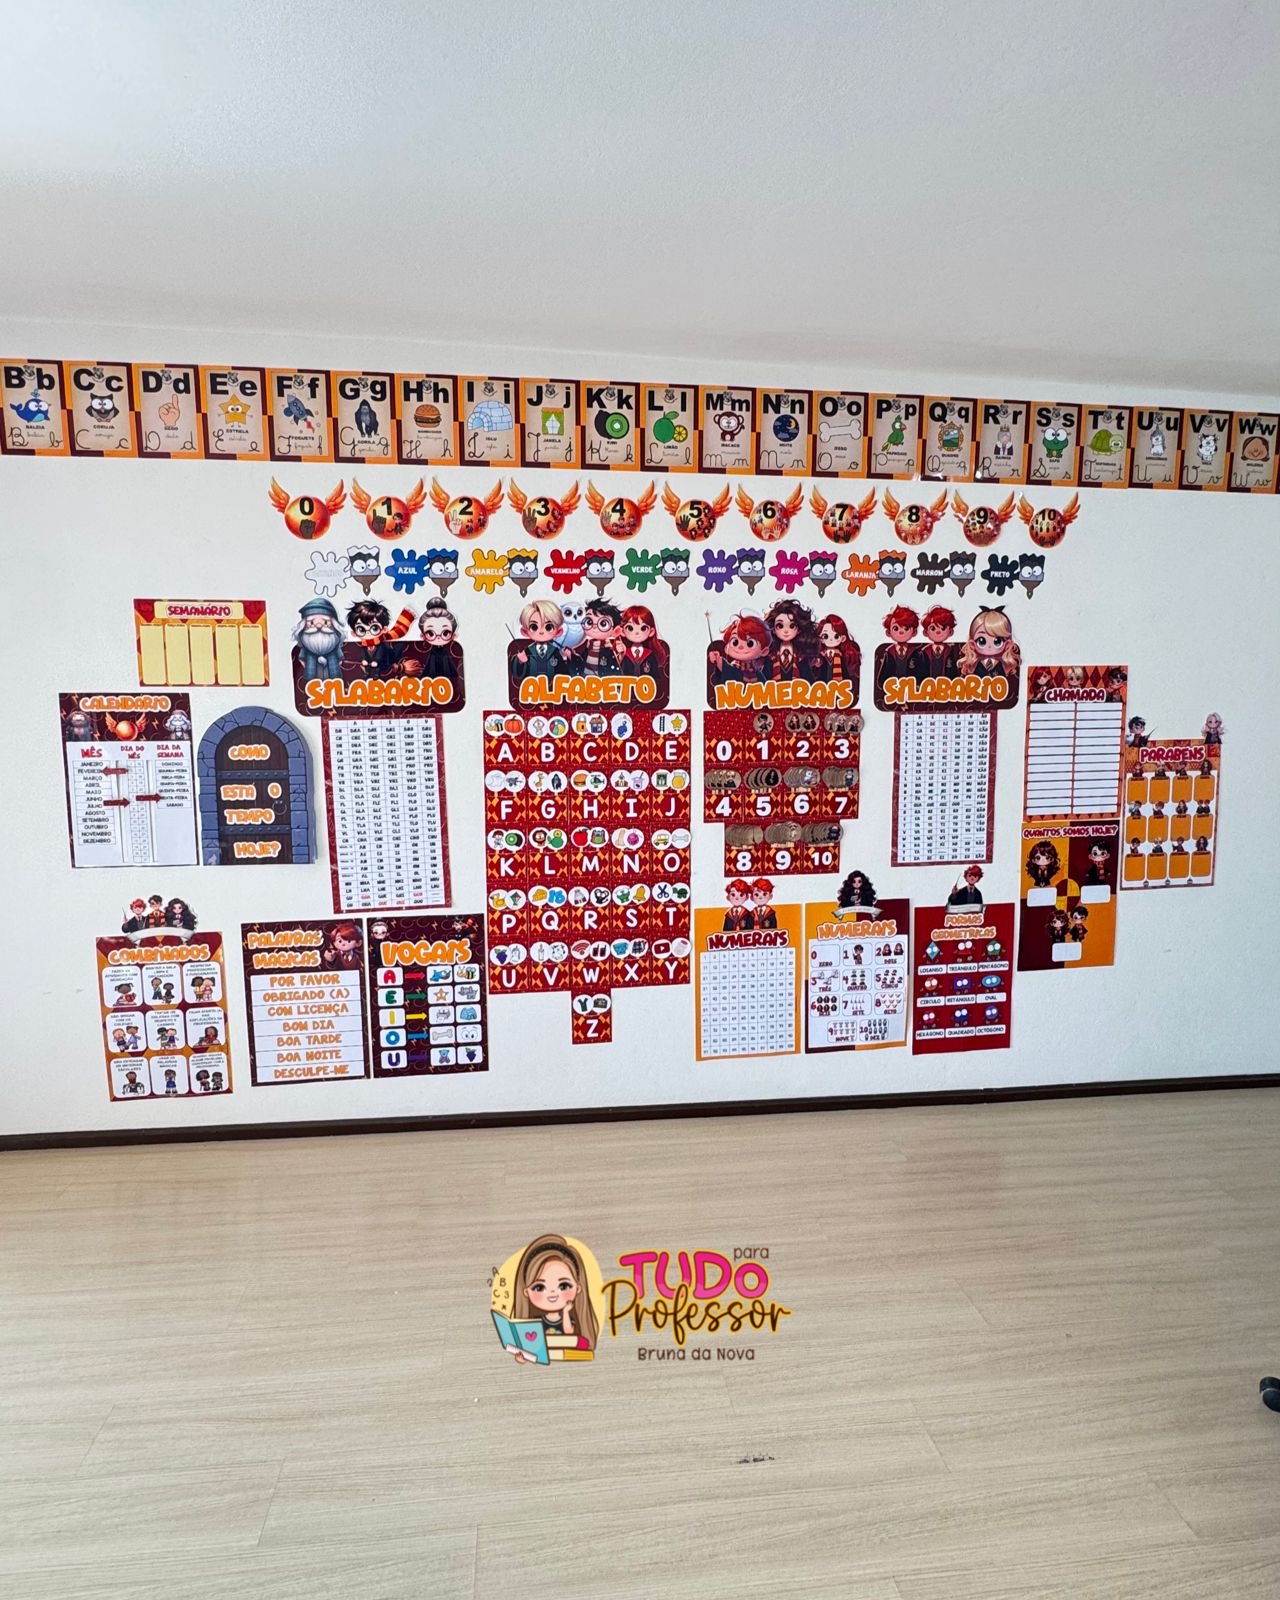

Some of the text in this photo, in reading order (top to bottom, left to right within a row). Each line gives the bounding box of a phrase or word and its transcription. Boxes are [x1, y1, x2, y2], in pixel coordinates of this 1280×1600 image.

[299, 497, 315, 516] 0
[382, 497, 393, 516] 1
[459, 497, 474, 516] 2
[536, 497, 551, 517] 3
[611, 498, 626, 516] 4
[689, 501, 703, 518] 5
[762, 501, 776, 519] 6
[835, 504, 849, 521] 7
[908, 505, 920, 523] 8
[1038, 509, 1056, 521] 10
[976, 507, 988, 524] 9
[398, 566, 418, 575] AZUL
[469, 567, 504, 576] AMARELO
[550, 567, 581, 575] VERMELHO
[631, 565, 653, 574] VERDE
[708, 566, 727, 574] ROXO
[780, 567, 799, 575] ROSA
[845, 570, 878, 579] LARANJA
[916, 569, 944, 577] MARROM
[990, 570, 1010, 578] PRETO
[519, 675, 656, 705] ALFABETO
[715, 680, 853, 709] NUMERAIS
[1045, 688, 1106, 703] CHAMADA
[81, 746, 103, 758] MÊS
[228, 744, 271, 760] COMO
[497, 745, 514, 762] A
[541, 746, 555, 762] B
[583, 745, 597, 761] C
[625, 744, 639, 761] D
[665, 741, 678, 760] E
[716, 740, 732, 761] 0
[756, 740, 769, 760] 1
[796, 740, 810, 757] 2
[834, 738, 850, 759] 3
[268, 782, 282, 798] O
[500, 801, 513, 820] F
[541, 800, 556, 819] G
[583, 799, 598, 817] H
[626, 798, 638, 817] I
[665, 797, 676, 817] J
[715, 797, 732, 816] 4
[756, 796, 772, 816] 5
[794, 794, 810, 814] 6
[835, 797, 848, 813] 7
[224, 808, 275, 825] TEMPO
[1023, 825, 1118, 839] QUANTOS SOMOS HOJE?
[233, 841, 281, 858] HOJE?
[500, 858, 515, 876] K
[544, 856, 556, 875] L
[582, 856, 599, 872] M
[623, 855, 640, 873] N
[663, 853, 680, 872] O
[736, 851, 752, 871] 8
[775, 850, 791, 870] 9
[811, 852, 832, 866] 10
[502, 914, 516, 933] P
[542, 911, 560, 931] Q
[584, 911, 598, 929] R
[626, 908, 638, 928] S
[665, 907, 677, 926] T
[944, 914, 984, 927] FORMAS
[816, 920, 897, 940] NUMERAIS
[247, 929, 324, 949] PALAVRAS
[707, 930, 789, 951] NUMERAIS
[107, 944, 210, 965] COMBINADOS
[381, 939, 472, 966] VOGAIS
[384, 970, 396, 984] A
[502, 969, 516, 987] U
[543, 967, 559, 986] V
[583, 967, 600, 983] W
[624, 963, 639, 981] X
[664, 961, 678, 980] Y
[270, 974, 340, 987] POR FAVOR
[263, 989, 350, 1002] OBRIGADO (A)
[385, 990, 397, 1004] E
[268, 1003, 348, 1016] COM LICENÇA
[389, 1011, 396, 1025] I
[283, 1019, 335, 1032] BOM DIA
[586, 1019, 598, 1038] Z
[277, 1034, 342, 1047] BOA TARDE
[385, 1031, 400, 1045] O
[277, 1050, 342, 1063] BOA NOITE
[387, 1052, 400, 1067] U
[274, 1065, 349, 1079] DESCULPE-ME
